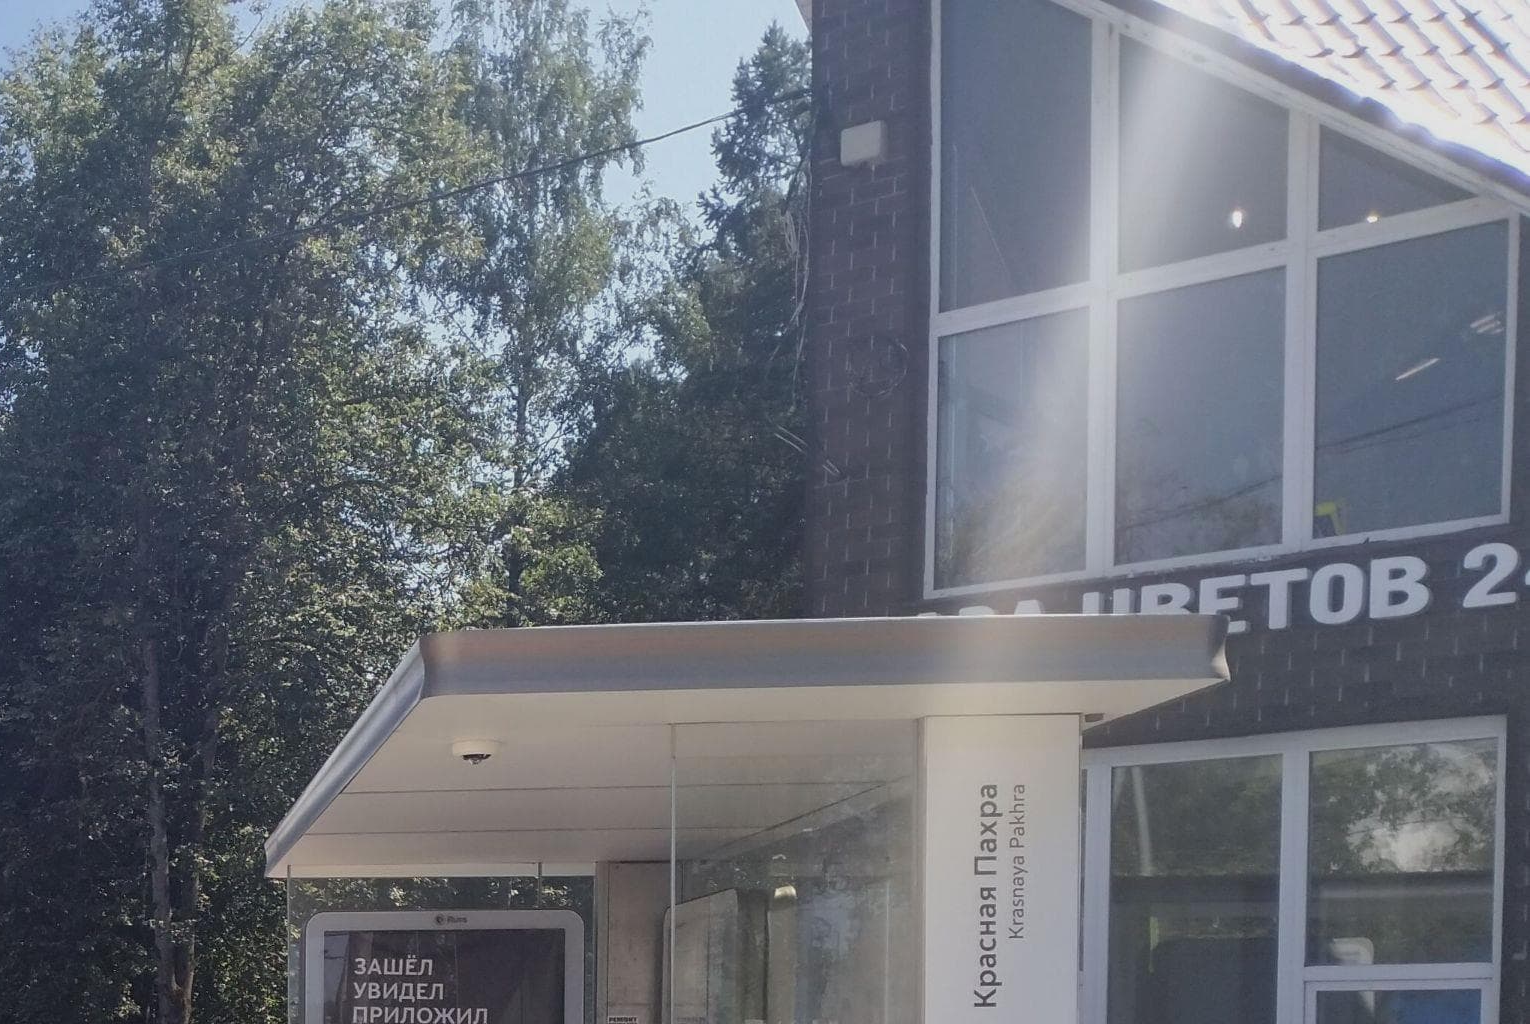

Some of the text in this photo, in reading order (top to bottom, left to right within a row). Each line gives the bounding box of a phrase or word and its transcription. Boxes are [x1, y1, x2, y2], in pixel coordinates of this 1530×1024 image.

[1463, 542, 1530, 609] 2
[1008, 784, 1028, 939] Krasnaya Pakhra
[973, 784, 1003, 1007] Красная Пахра
[353, 954, 433, 976] ЗАШЁЛ
[353, 982, 444, 1002] УВИДЕЛ
[352, 1006, 488, 1024] ПРИЛОЖИЛ
